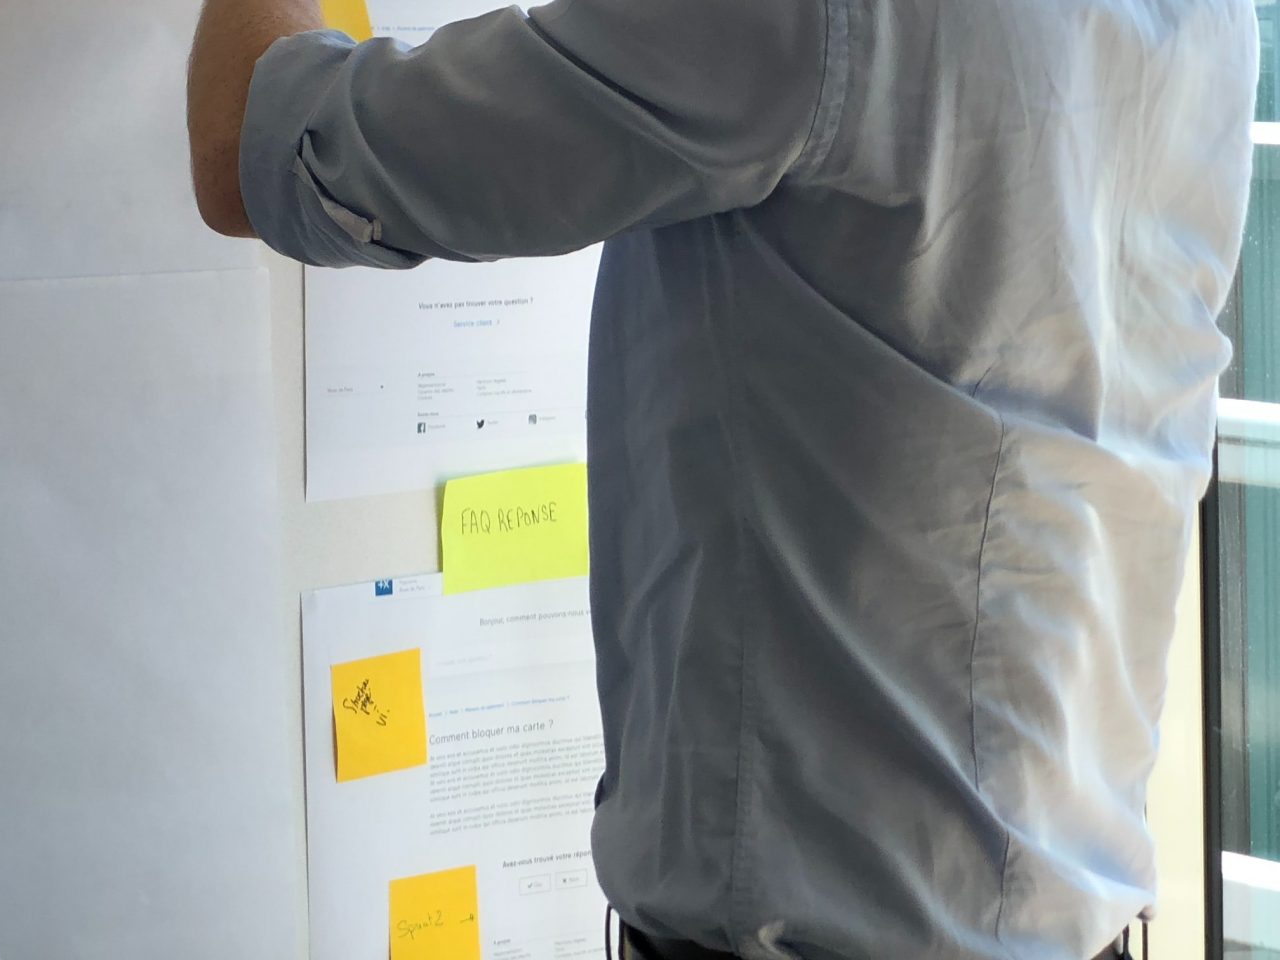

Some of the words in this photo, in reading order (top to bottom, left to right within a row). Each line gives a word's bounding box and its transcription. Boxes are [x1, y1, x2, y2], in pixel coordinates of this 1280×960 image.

[461, 507, 491, 535] FAQ
[497, 501, 558, 533] REPONSE
[429, 731, 469, 745] Comment
[472, 726, 504, 740] bloquer
[507, 725, 520, 734] ma
[523, 722, 546, 732] carte
[548, 719, 554, 729] ?
